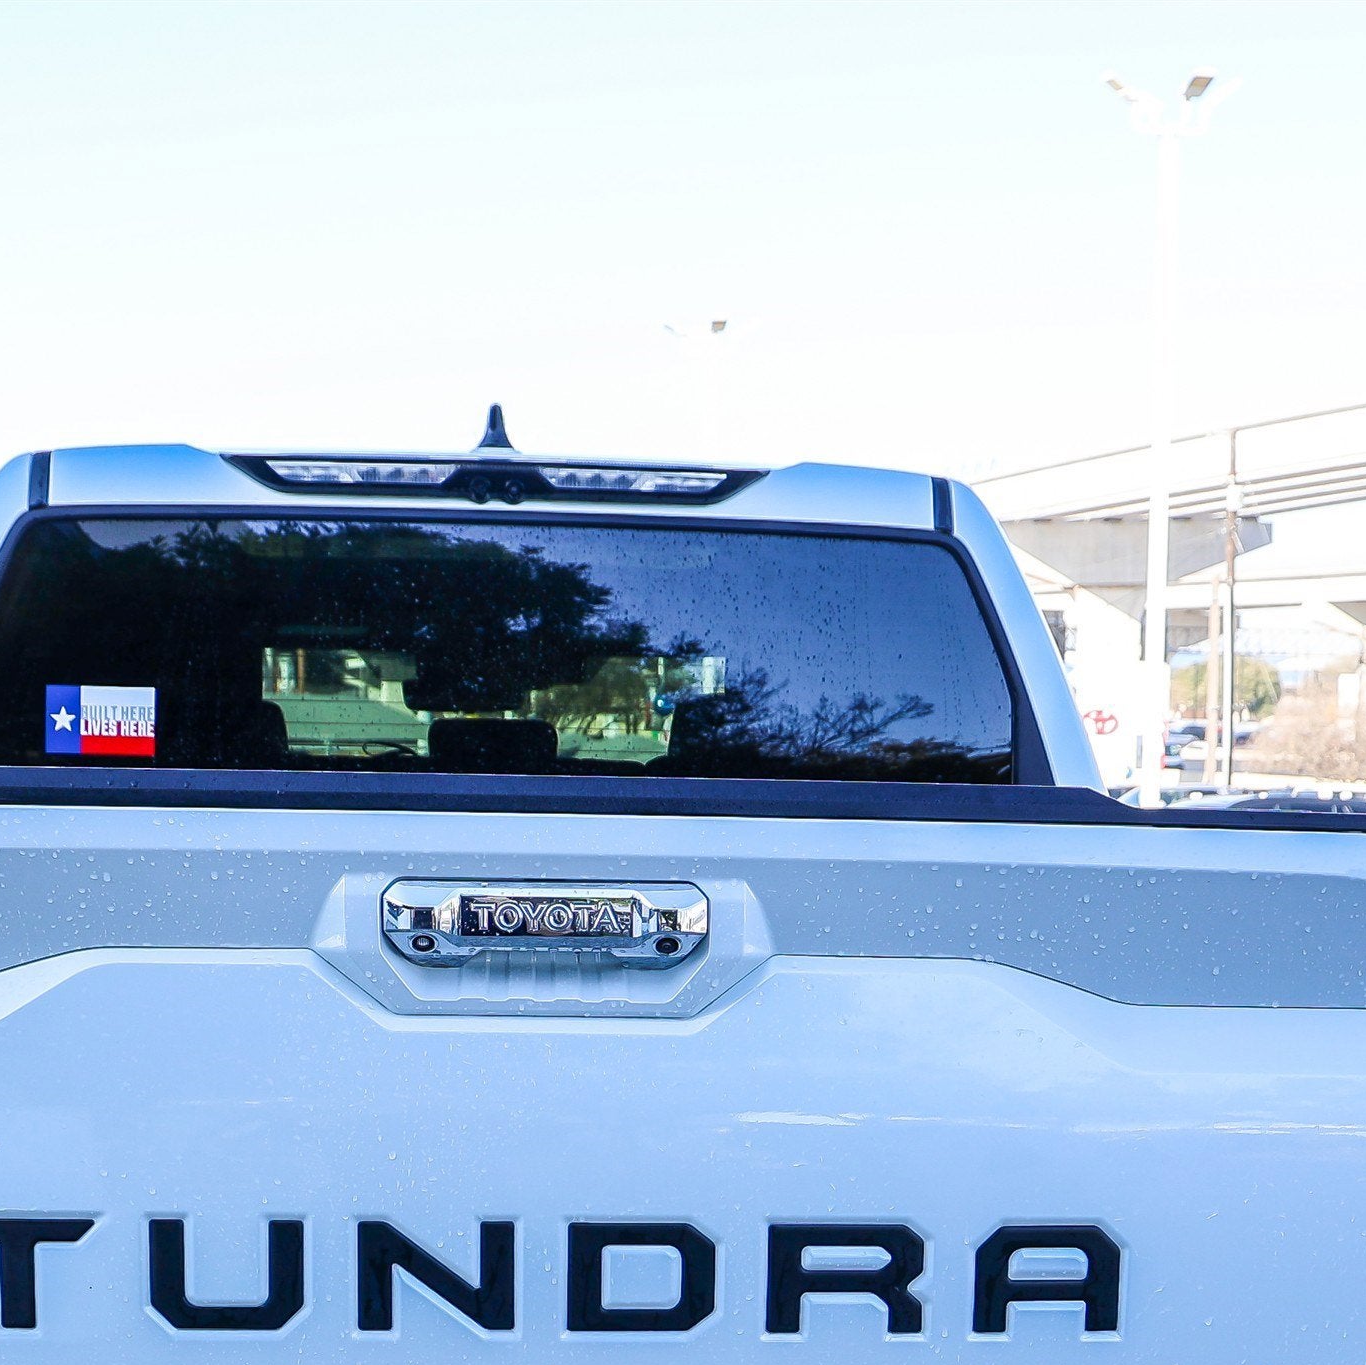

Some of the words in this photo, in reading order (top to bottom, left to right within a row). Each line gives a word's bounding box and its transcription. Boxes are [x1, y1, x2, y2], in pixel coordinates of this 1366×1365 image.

[82, 705, 117, 720] BUILT
[121, 706, 154, 721] HERE
[81, 720, 117, 736] LIVES
[121, 721, 155, 737] HERE
[471, 901, 622, 932] TOYOTA
